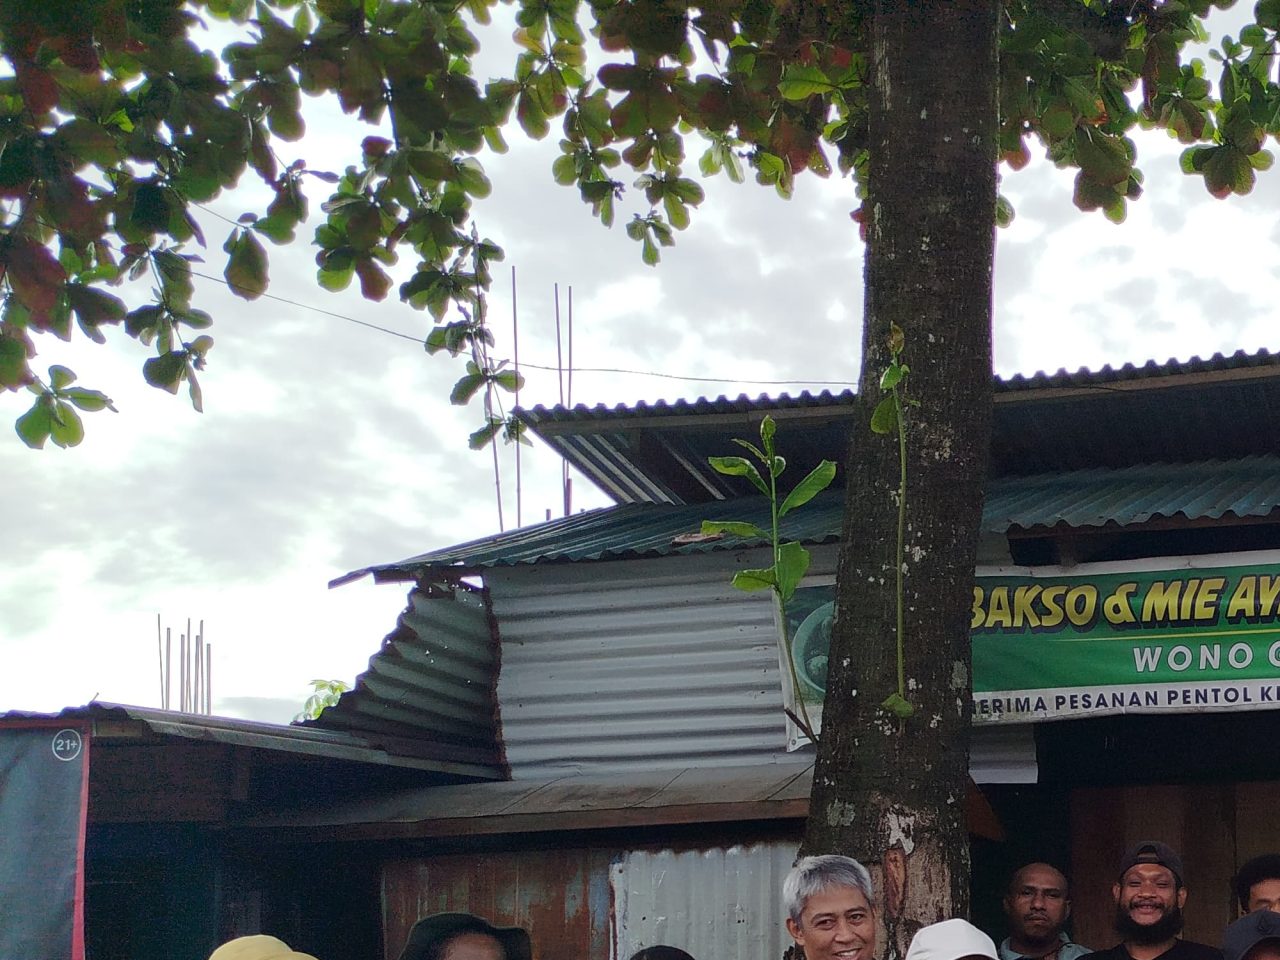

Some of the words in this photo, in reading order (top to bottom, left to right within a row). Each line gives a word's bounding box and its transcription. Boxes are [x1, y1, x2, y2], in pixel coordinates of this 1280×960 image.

[971, 584, 1099, 631] BAKSO
[1141, 577, 1226, 623] MIE
[1133, 642, 1254, 672] WONO
[1055, 690, 1158, 711] PESANAN
[1167, 687, 1252, 706] PENTOL
[56, 739, 78, 750] 21+
